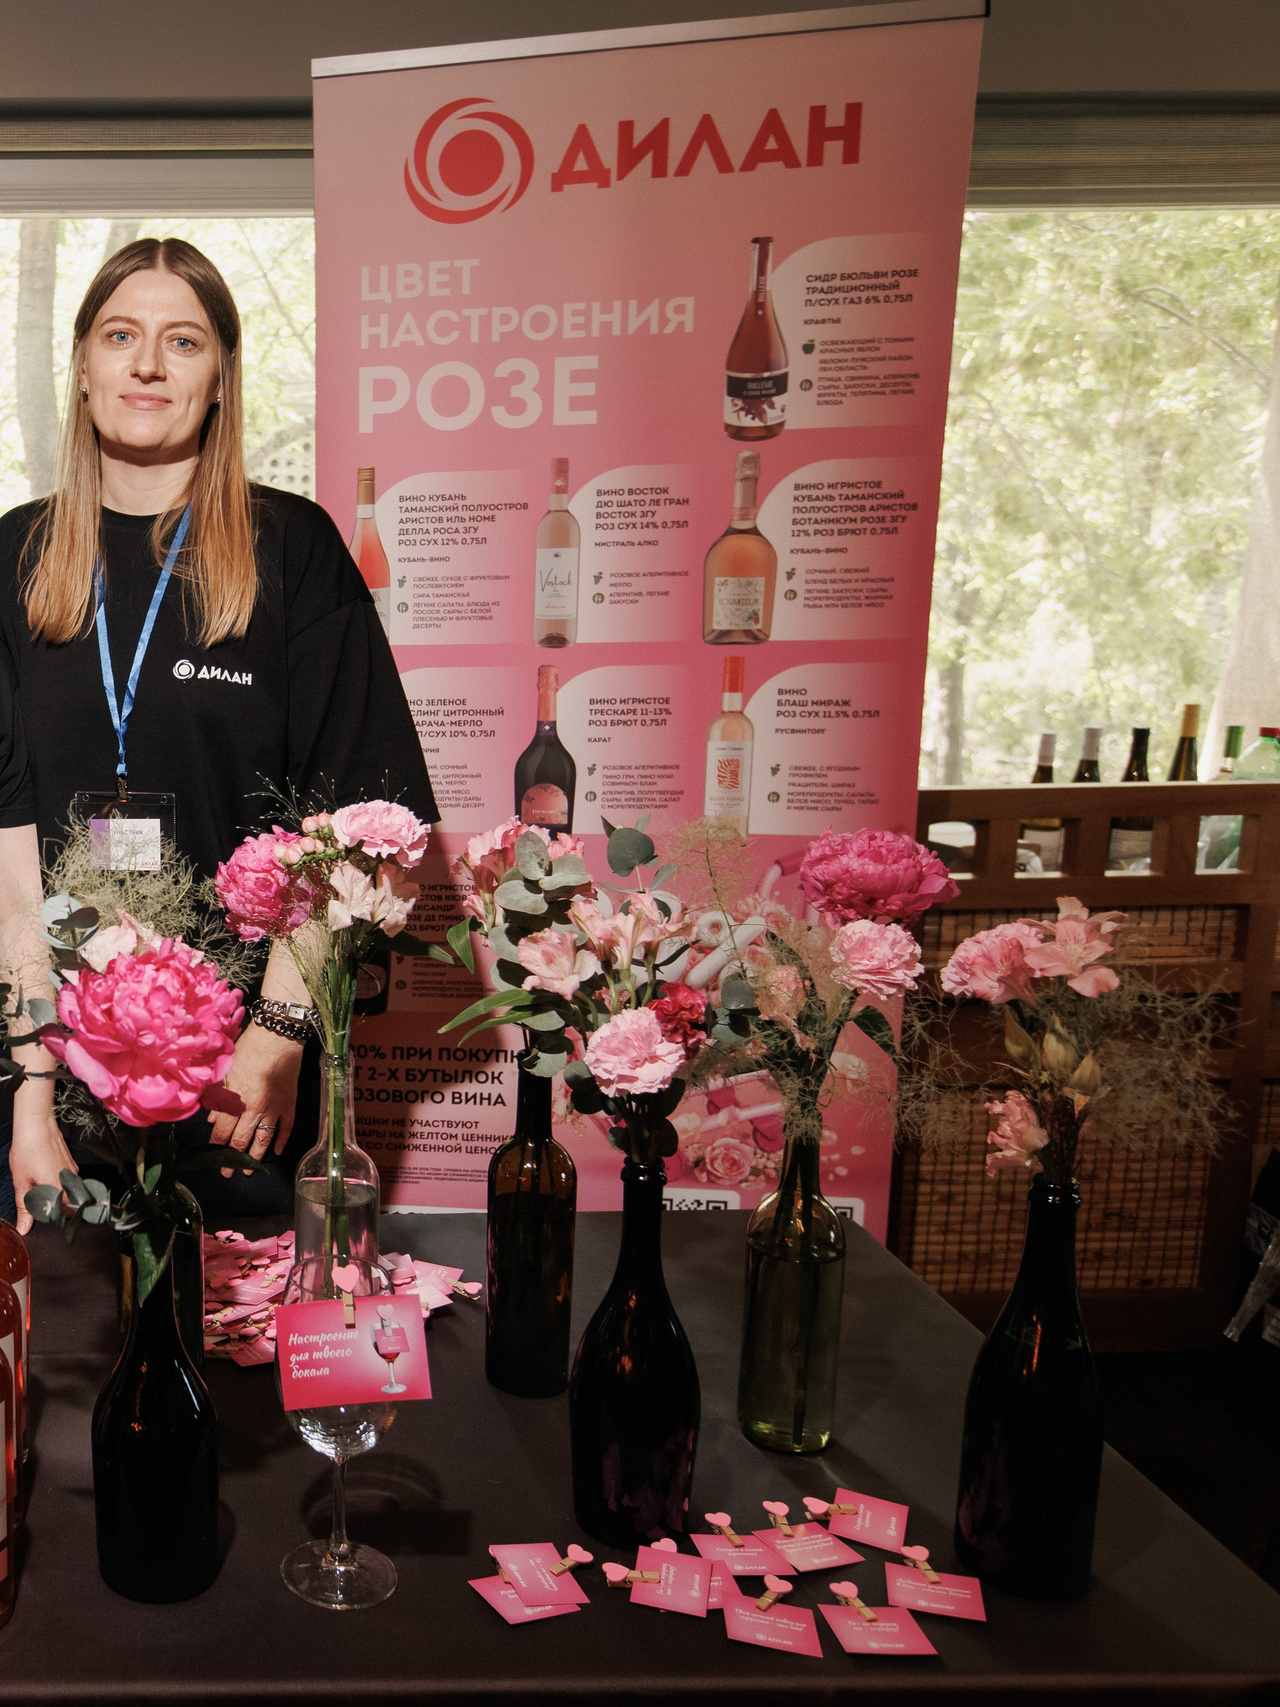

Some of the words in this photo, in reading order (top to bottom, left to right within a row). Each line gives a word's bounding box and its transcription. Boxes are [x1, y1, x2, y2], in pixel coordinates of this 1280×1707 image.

[550, 101, 863, 192] ДИЛАН
[360, 259, 479, 304] ЦВЕТ
[806, 273, 837, 283] СИДР
[840, 271, 888, 281] БЮЛЬВИ
[891, 269, 919, 278] РОЗЕ
[806, 281, 900, 295] ТРАДИЦИОННЫЙ
[805, 297, 840, 307] П/СУХ
[842, 297, 862, 305] ГАЗ
[865, 296, 881, 304] 6%
[360, 296, 695, 349] НАСТРОЕНИЯ
[358, 355, 599, 434] РОЗЕ
[794, 483, 824, 491] ВИНО
[827, 481, 882, 490] ИГРИСТОЕ
[597, 489, 625, 497] ВИНО
[628, 487, 669, 496] ВОСТОК
[794, 494, 836, 502] КУБАНЬ
[838, 490, 904, 501] ТАМАНСКИЙ
[399, 495, 426, 503] ВИНО
[428, 494, 467, 502] КУБАНЬ
[596, 501, 613, 509] ДЮ
[664, 498, 689, 506] ГРАН
[399, 504, 459, 514] ТАМАНСКИЙ
[462, 502, 528, 512] ПОЛУОСТРОВ
[793, 504, 866, 514] ПОЛУОСТРОВ
[869, 503, 918, 512] АРИСТОВ
[596, 511, 637, 519] ВОСТОК
[640, 510, 657, 518] ЗГУ
[398, 517, 443, 525] АРИСТОВ
[792, 517, 857, 526] БОТАНИКУМ
[860, 516, 886, 524] РОЗЕ
[889, 515, 907, 523] ЗГУ
[398, 528, 430, 536] ДЕЛЛА
[433, 527, 460, 535] РОСА
[462, 526, 479, 534] ЗГУ
[596, 523, 615, 531] РОЗ
[618, 522, 637, 530] СУХ
[791, 529, 810, 537] 12%
[838, 528, 867, 536] БРЮТ
[420, 538, 438, 546] СУХ
[461, 537, 487, 546] 0,75Л
[198, 665, 253, 685] ДИЛАН
[425, 698, 467, 706] ЗЕЛЕНОЕ
[589, 698, 617, 706] ВИНО
[620, 697, 671, 705] ИГРИСТОЕ
[811, 699, 851, 707] МИРАЖ
[410, 709, 441, 717] СЛИНГ
[443, 707, 504, 717] ЦИТРОННЫЙ
[589, 708, 638, 716] ТРЕСКАРЕ
[589, 719, 608, 727] РОЗ
[610, 719, 638, 727] БРЮТ
[449, 730, 468, 738] 10%
[392, 1046, 432, 1061] ПРИ
[368, 1068, 399, 1081] 2-Х
[405, 1068, 503, 1085] БУТЫЛОК
[353, 1089, 445, 1104] ОЗОВОГО
[451, 1092, 506, 1107] ВИНА
[392, 1118, 406, 1126] НЕ
[410, 1120, 479, 1129] УЧАСТВУЮТ
[390, 1130, 405, 1139] НА
[408, 1131, 458, 1141] ЖЕЛТОМ
[366, 1142, 381, 1150] СО
[386, 1141, 462, 1153] СНИЖЕННОЙ
[465, 1145, 497, 1155] ЦЕНО
[288, 1331, 359, 1346] Настроение
[289, 1353, 309, 1367] для
[313, 1345, 351, 1360] твоего
[292, 1365, 330, 1379] бокала
